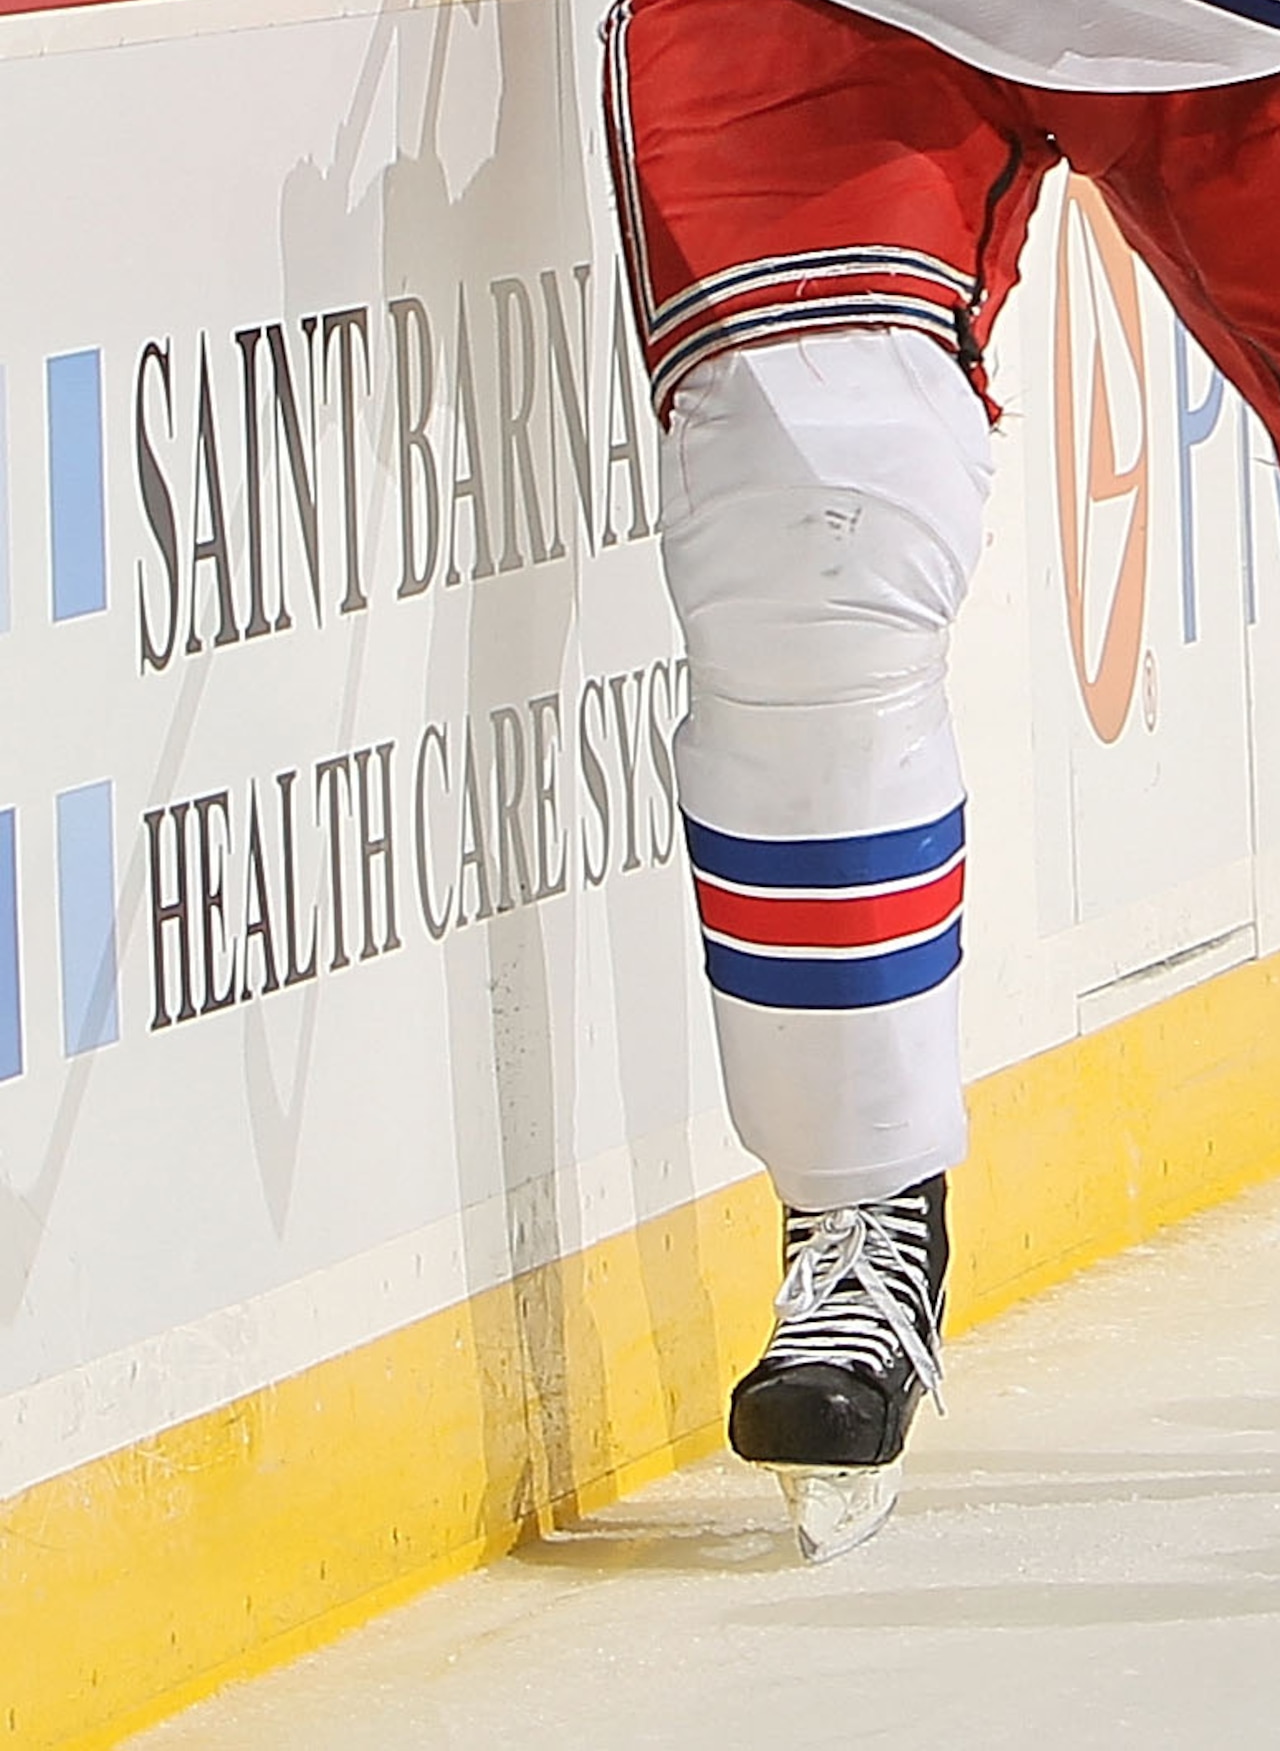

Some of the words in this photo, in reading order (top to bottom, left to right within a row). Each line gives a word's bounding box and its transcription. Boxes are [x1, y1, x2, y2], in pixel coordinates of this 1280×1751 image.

[135, 305, 372, 678] SAINT
[388, 250, 662, 602] BARNA
[143, 740, 403, 1032] HEALTH
[414, 691, 568, 942] CARE
